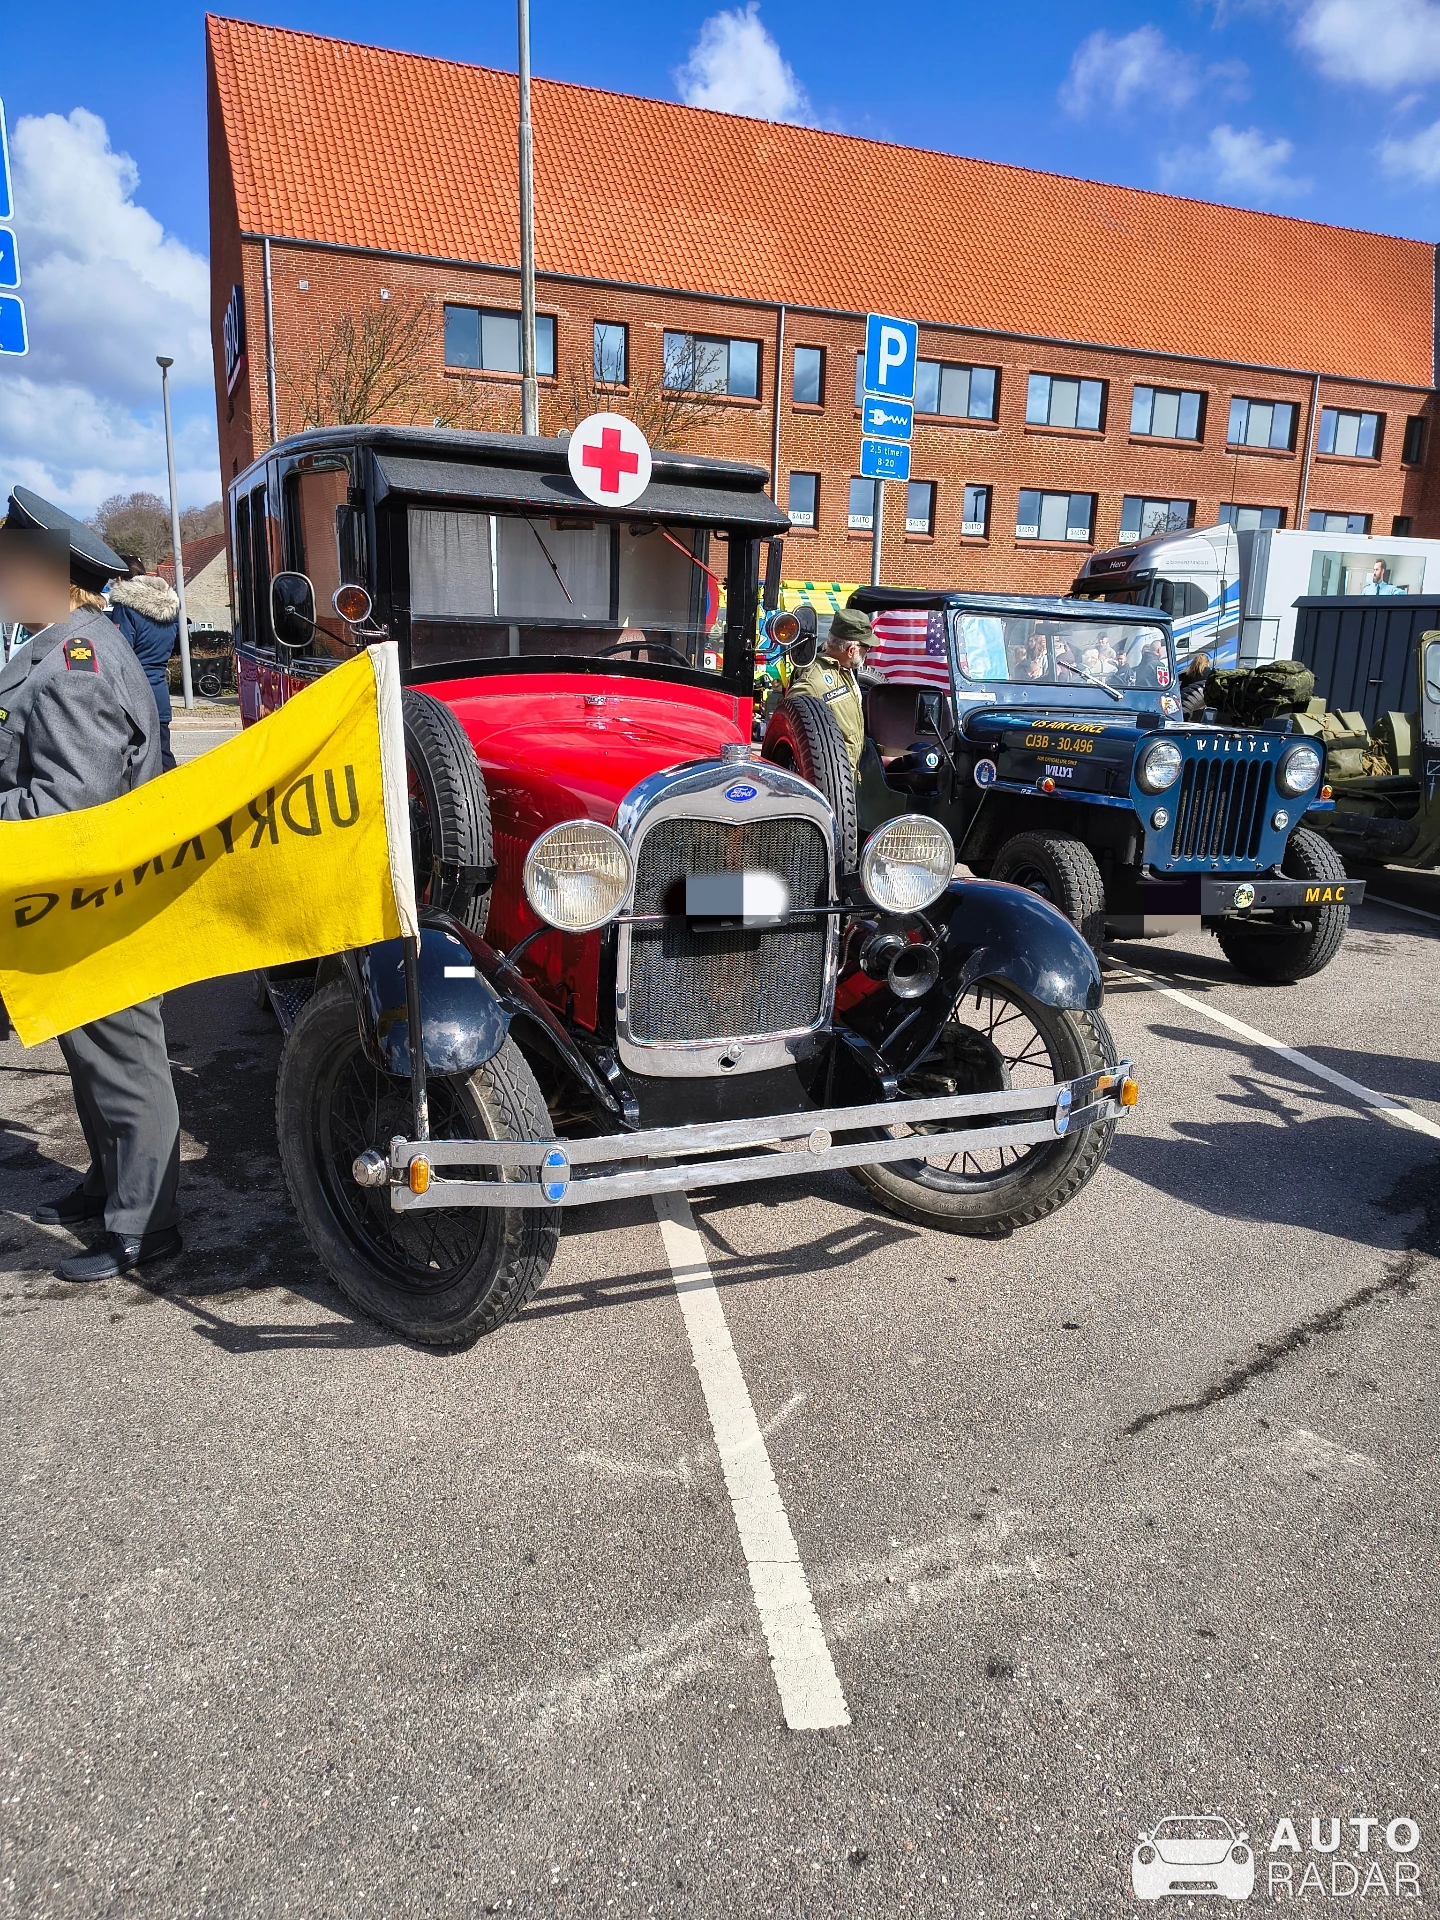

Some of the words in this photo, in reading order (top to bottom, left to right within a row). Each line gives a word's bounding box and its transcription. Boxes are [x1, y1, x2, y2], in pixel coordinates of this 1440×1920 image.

[877, 325, 908, 386] P
[870, 445, 882, 455] 2,5
[884, 446, 903, 457] timer
[851, 516, 870, 524] SALTO
[1018, 525, 1035, 533] SALTO
[1070, 528, 1087, 536] SALTO
[1109, 561, 1126, 569] Hero
[1031, 720, 1049, 728] US
[1047, 721, 1069, 730] AIR
[1067, 723, 1107, 734] FORCE
[1025, 734, 1049, 748] CJ3B
[1057, 737, 1094, 753] 30.496
[1197, 739, 1270, 753] WILLYS
[1045, 764, 1074, 778] WILLYS
[730, 787, 753, 798] Ford
[1305, 886, 1345, 903] MAC
